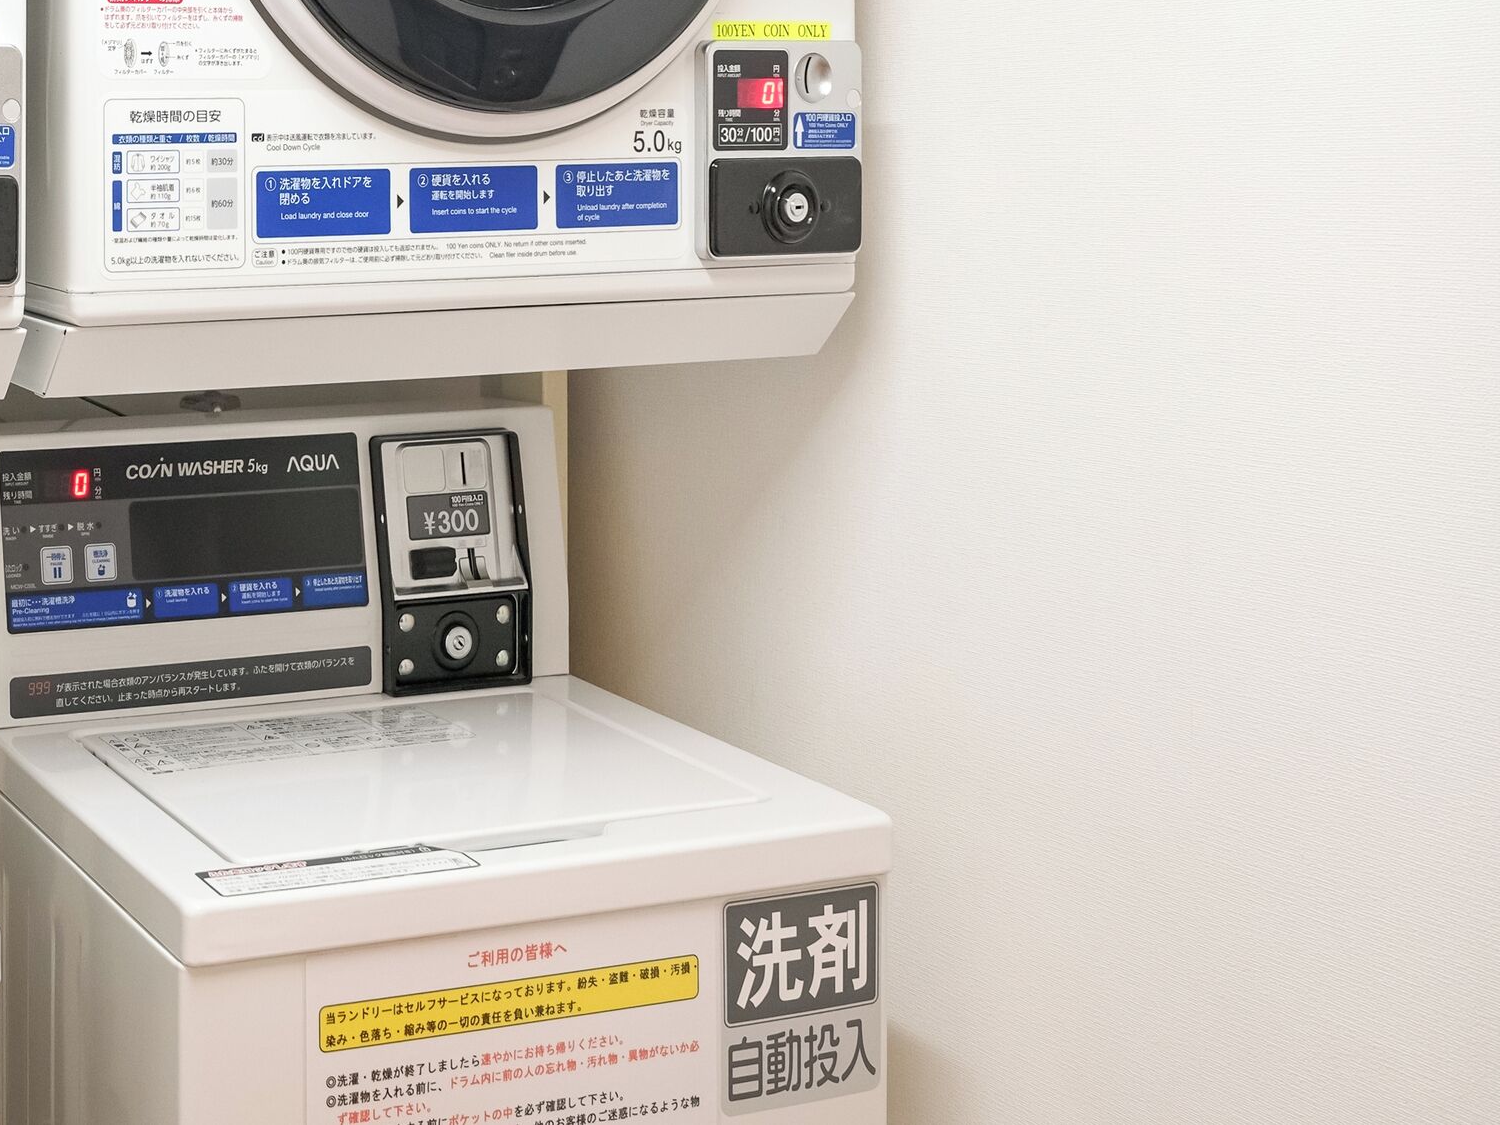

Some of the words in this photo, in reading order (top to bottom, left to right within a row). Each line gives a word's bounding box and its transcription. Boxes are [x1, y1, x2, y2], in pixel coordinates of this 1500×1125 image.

[717, 24, 756, 36] 100YEN
[764, 25, 790, 37] COIN
[798, 25, 828, 38] ONLY
[762, 82, 775, 104] 0
[130, 110, 221, 123] 乾燥時間の目安
[640, 109, 674, 118] 乾燥容量
[303, 143, 320, 151] Cycle
[212, 157, 233, 166] 約30分
[432, 173, 490, 186] 硬貨を入れる
[577, 170, 669, 182] 停止したあと洗濯物を
[280, 177, 372, 190] 洗濯物を入れドアを
[432, 189, 494, 201] 運転を開始します
[577, 185, 614, 197] 取り出す
[212, 200, 233, 208] 約60分
[280, 193, 310, 205] 閉める
[126, 457, 172, 479] COIN
[178, 460, 243, 475] WASHER
[248, 459, 268, 474] 5kg
[287, 454, 339, 472] AQUA
[2, 472, 31, 481] 投入金額
[94, 468, 101, 476] 円
[74, 472, 88, 496] 0
[3, 491, 32, 500] 残り時間
[95, 487, 101, 495] 分
[424, 509, 478, 535] ¥300
[165, 587, 209, 597] 洗濯物を入れる
[240, 582, 277, 591] 硬貨を入れる
[12, 607, 49, 615] Pre-Cleaning
[468, 941, 567, 968] ご利用の皆様へ
[737, 899, 868, 1009] 洗剤
[729, 1019, 876, 1101] 自動投入
[337, 1104, 431, 1124] ず確認して下さい。
